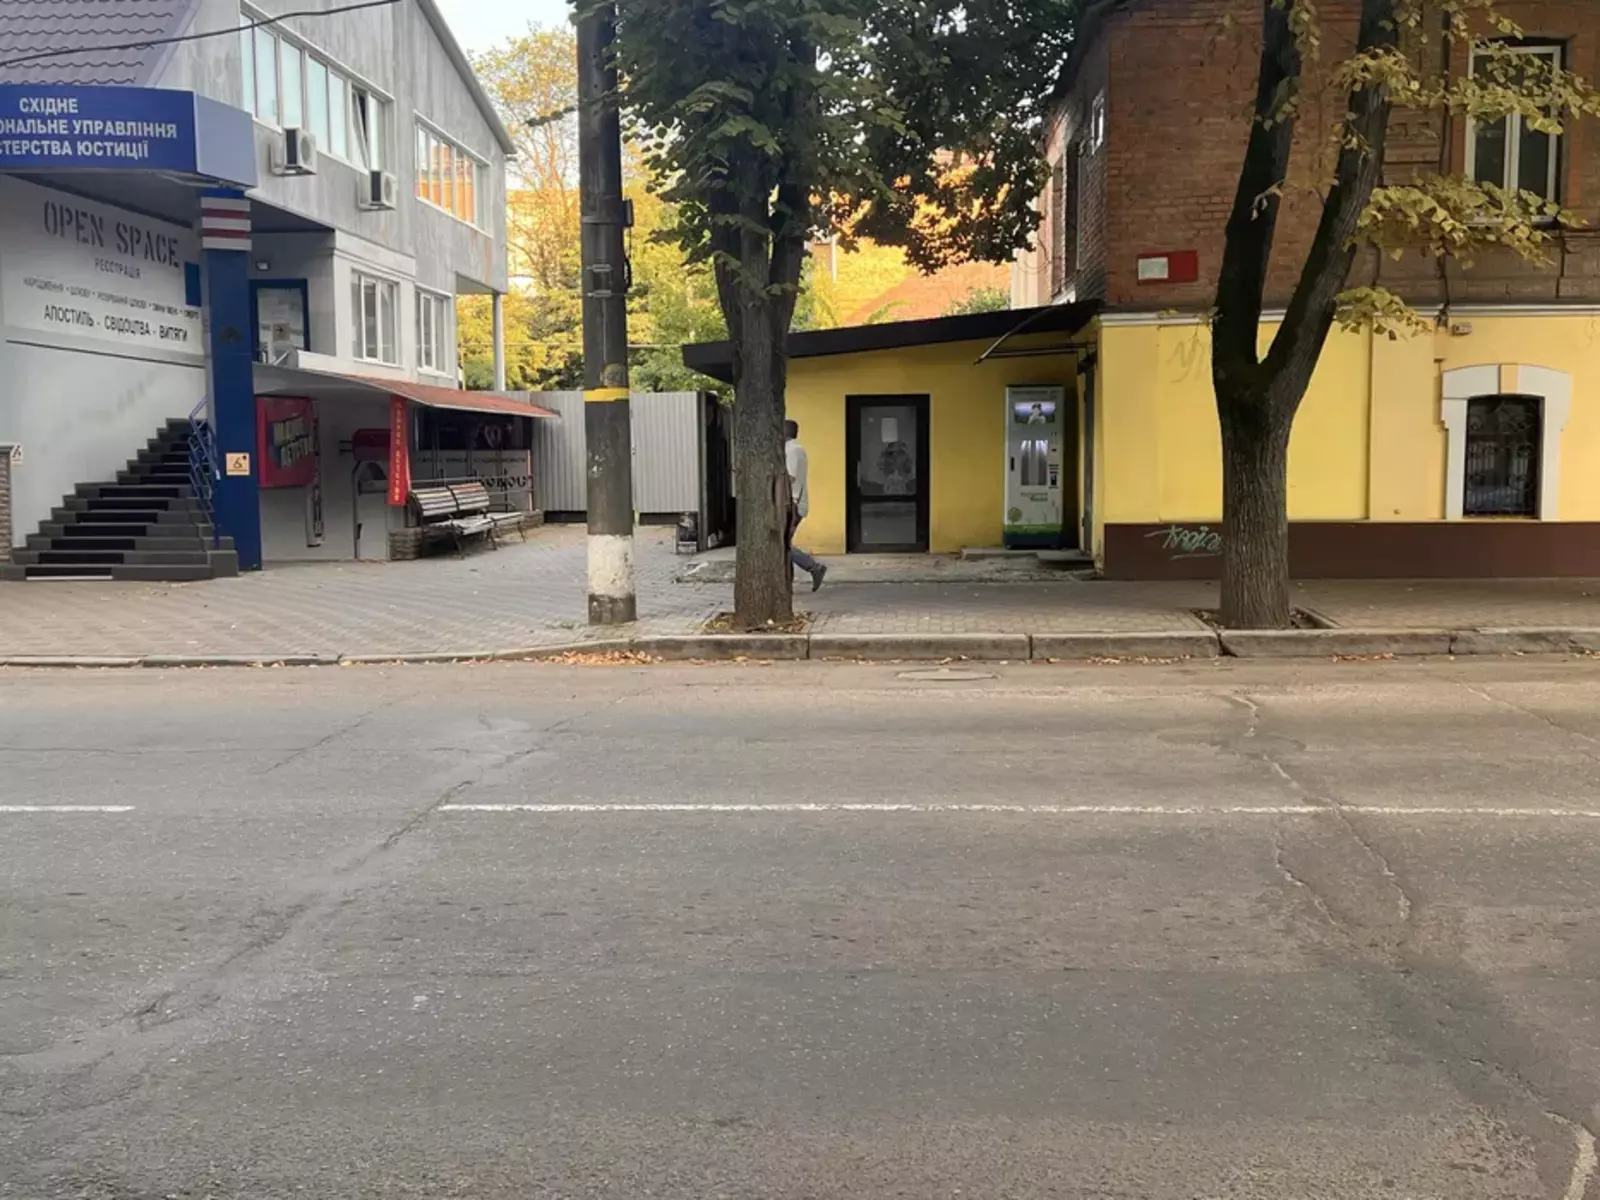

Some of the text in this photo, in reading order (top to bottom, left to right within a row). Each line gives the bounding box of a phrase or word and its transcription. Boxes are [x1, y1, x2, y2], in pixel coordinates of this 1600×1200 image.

[19, 98, 78, 115] СХІДНЕ
[73, 120, 177, 138] УПРАВЛІННЯ
[0, 140, 148, 159] ТЕРСТВА ЮСТИЦІЇ
[44, 200, 180, 268] OPEN SPACE
[44, 304, 188, 342] АПОСТИЛЬ СВІДОЦТВА ВИТЯГИ
